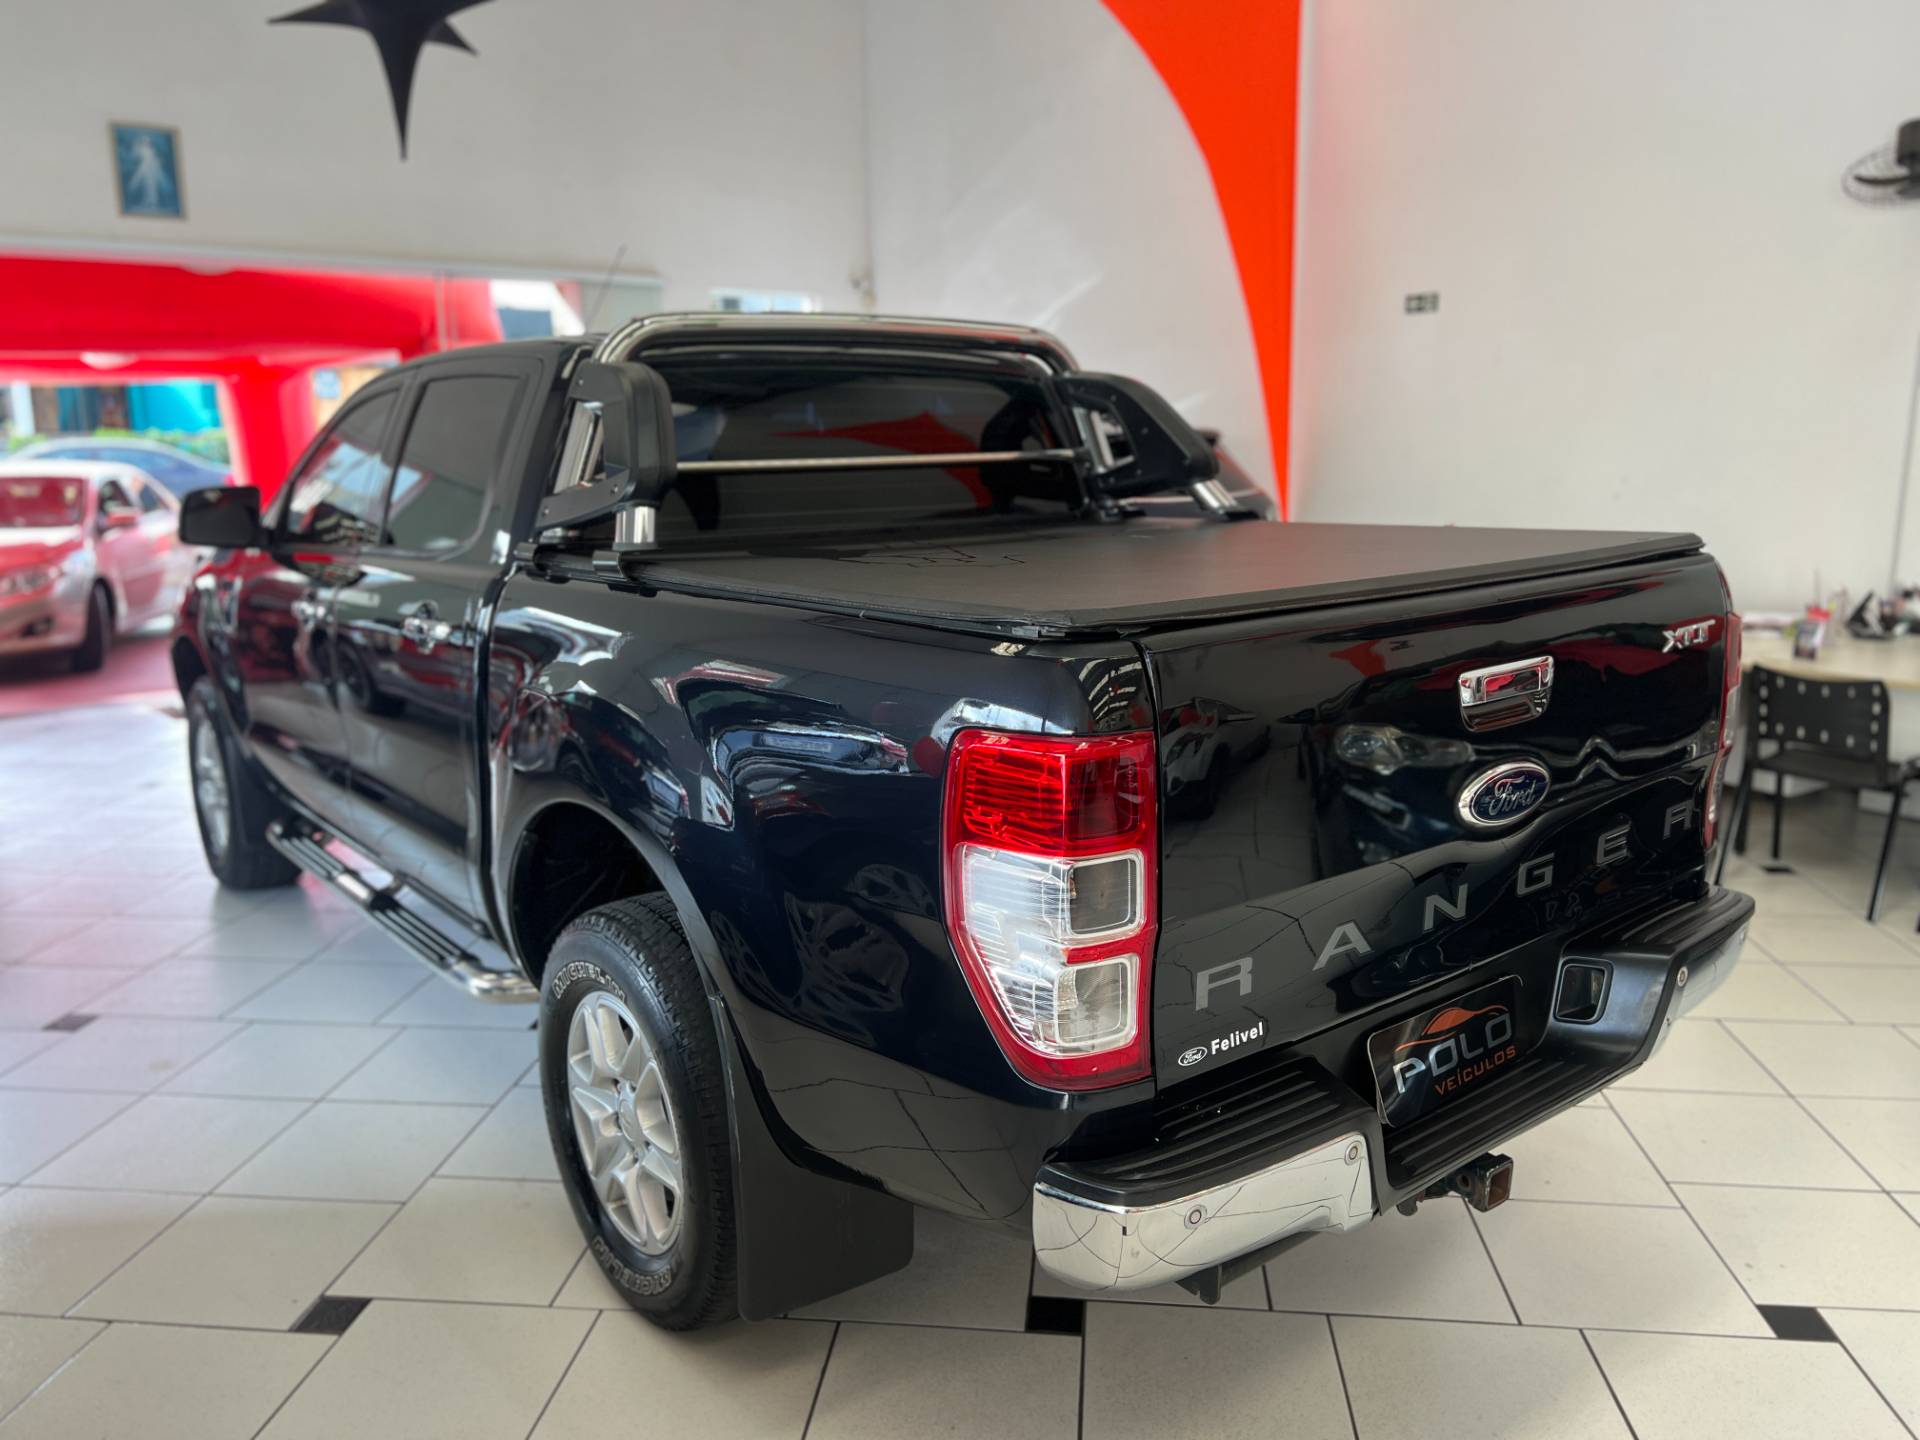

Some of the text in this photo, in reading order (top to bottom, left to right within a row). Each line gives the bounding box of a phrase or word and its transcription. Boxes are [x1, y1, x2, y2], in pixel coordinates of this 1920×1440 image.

[1489, 775, 1537, 816] Ford
[1195, 799, 1695, 1012] RANGER
[552, 961, 626, 1004] MICHELIN
[1211, 1021, 1264, 1055] Felivel
[1393, 1012, 1513, 1095] POLO
